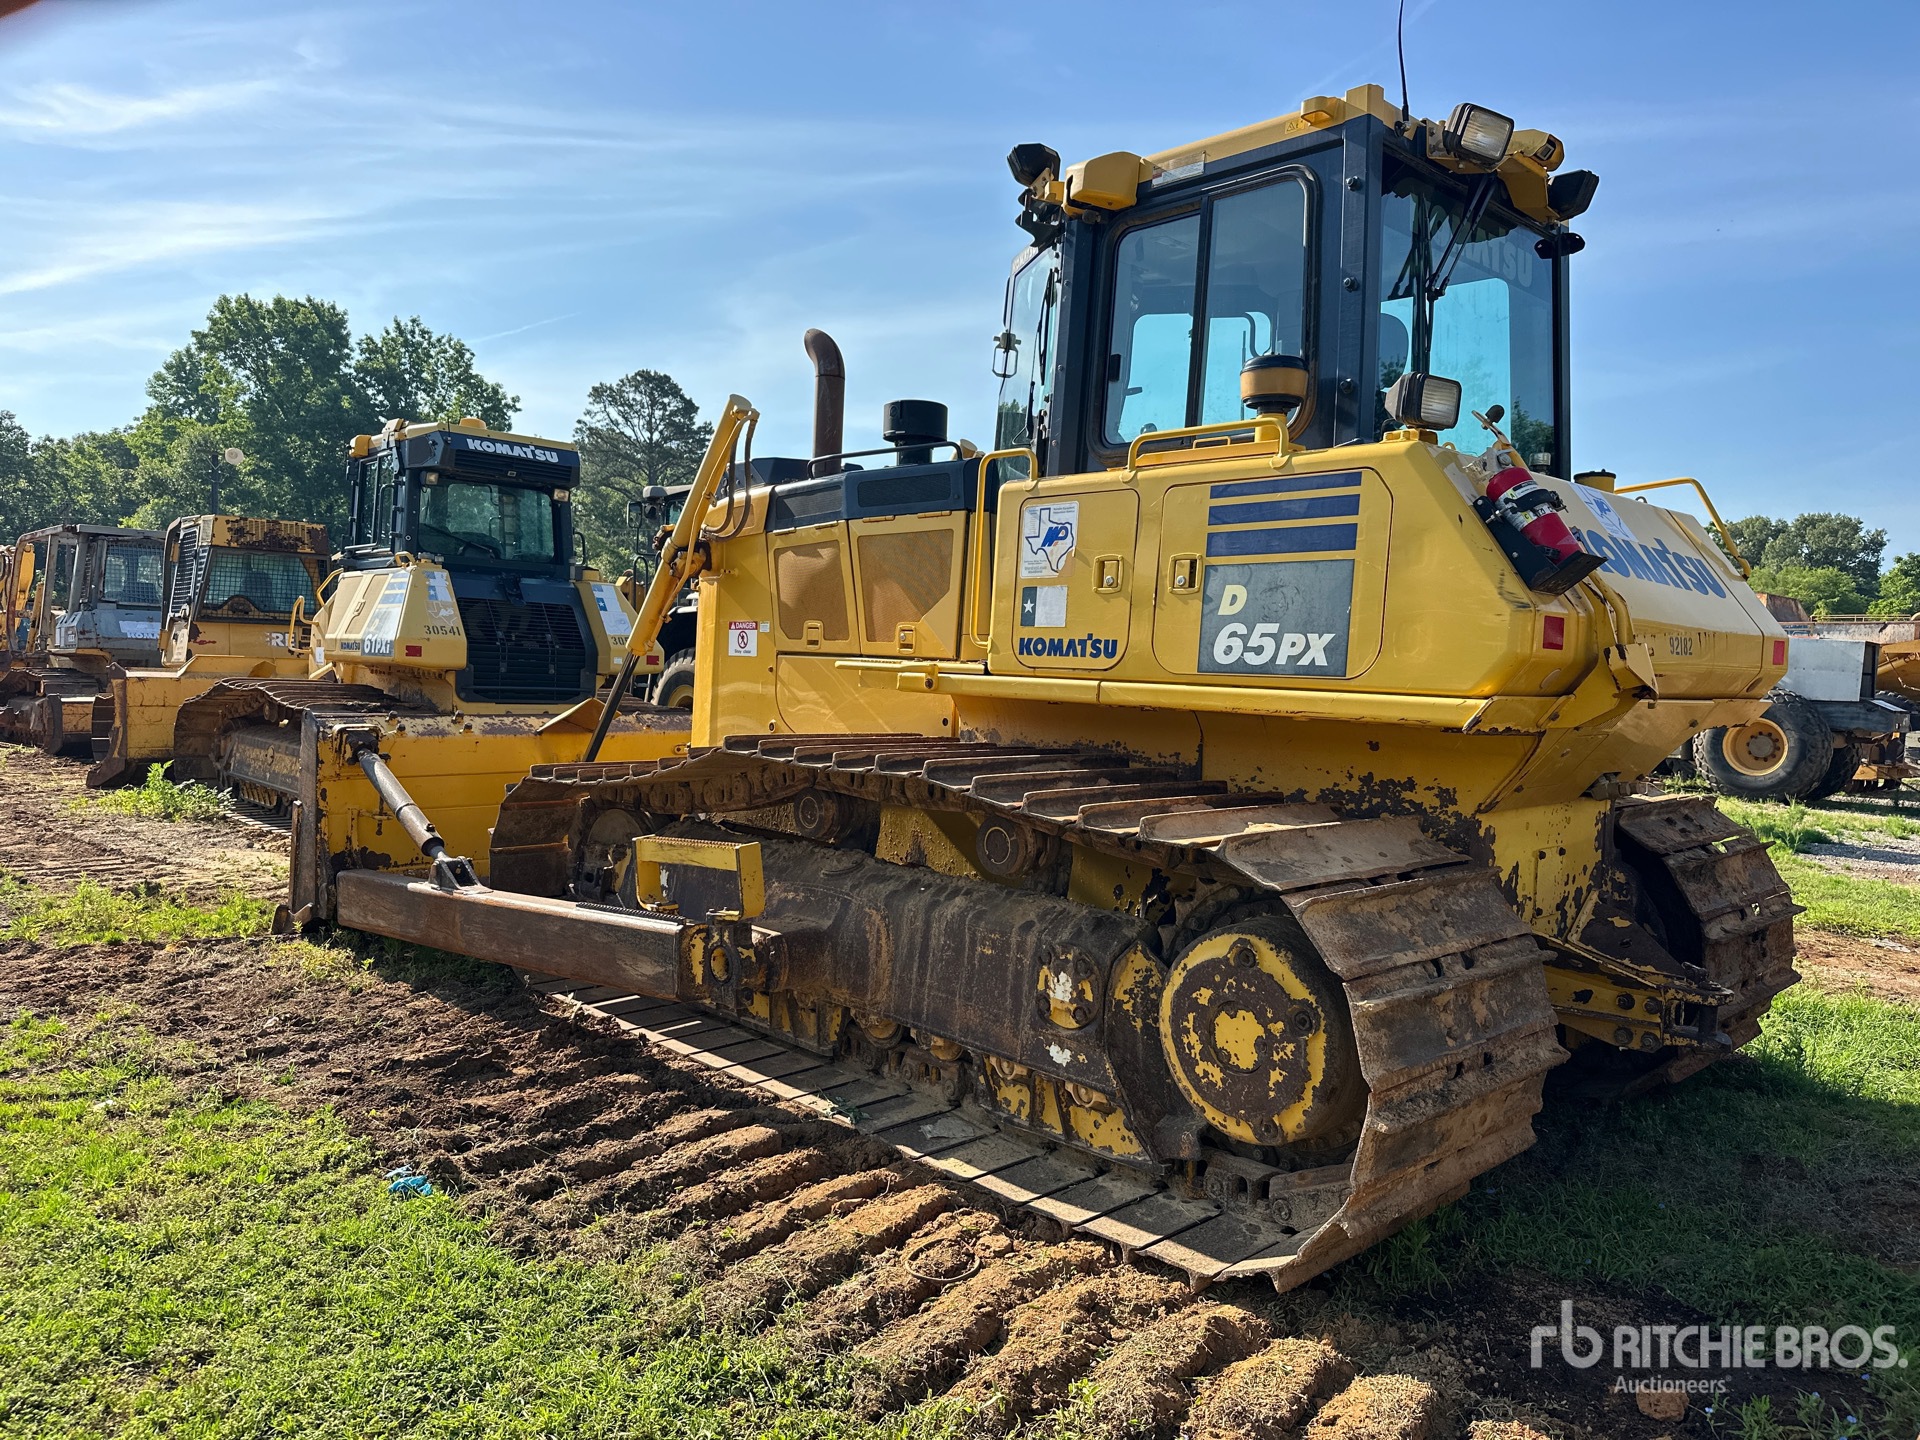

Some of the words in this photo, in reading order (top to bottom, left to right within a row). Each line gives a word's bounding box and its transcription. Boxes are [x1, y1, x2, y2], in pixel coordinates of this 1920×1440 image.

[466, 438, 559, 463] KOMATSU
[1217, 584, 1248, 616] D
[424, 625, 461, 636] 30541
[735, 622, 757, 630] DANGER
[1018, 633, 1118, 659] KOMATSU
[1213, 622, 1336, 666] 65PX
